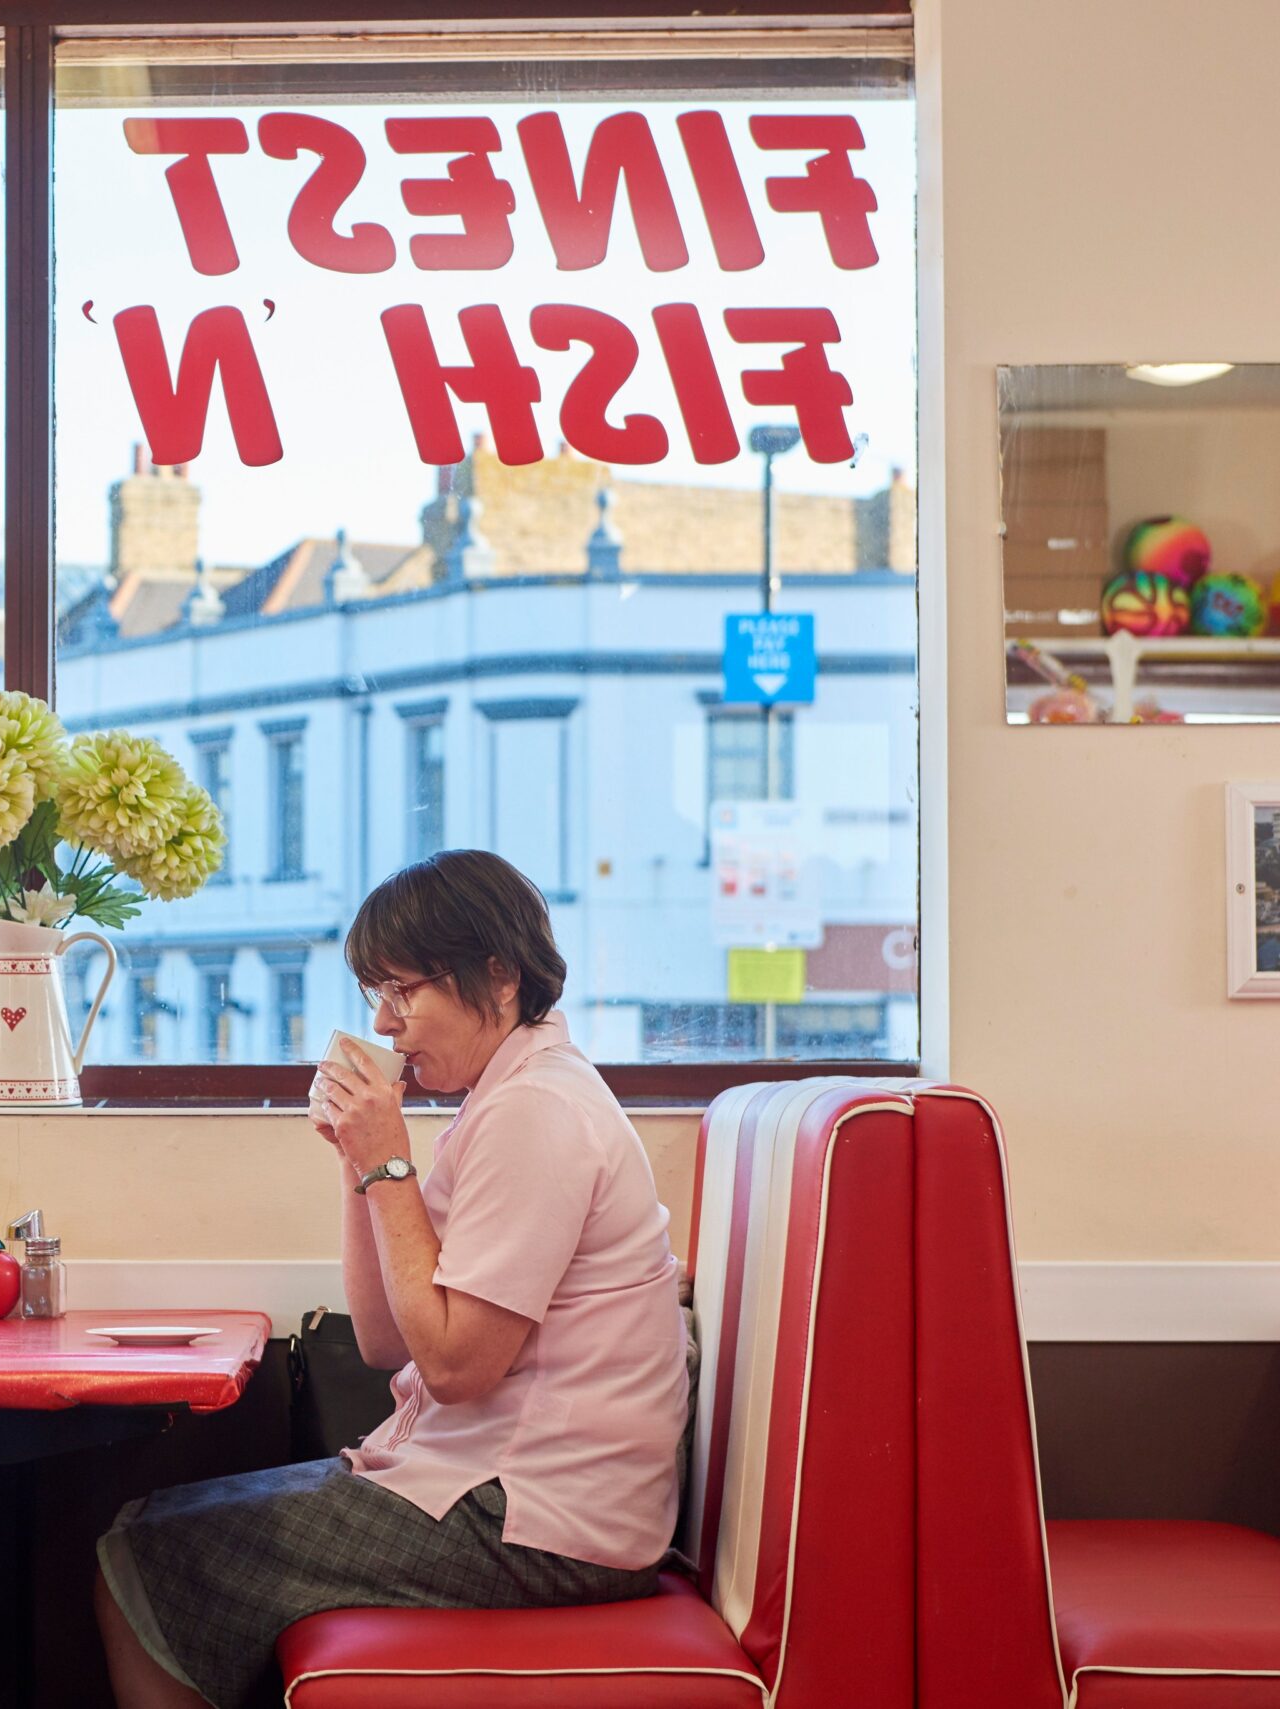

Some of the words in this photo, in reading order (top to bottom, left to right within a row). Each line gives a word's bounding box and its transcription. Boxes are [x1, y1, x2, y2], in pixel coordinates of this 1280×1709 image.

[738, 618, 800, 635] PLEASE
[753, 636, 786, 652] PAY
[746, 653, 790, 669] HERE
